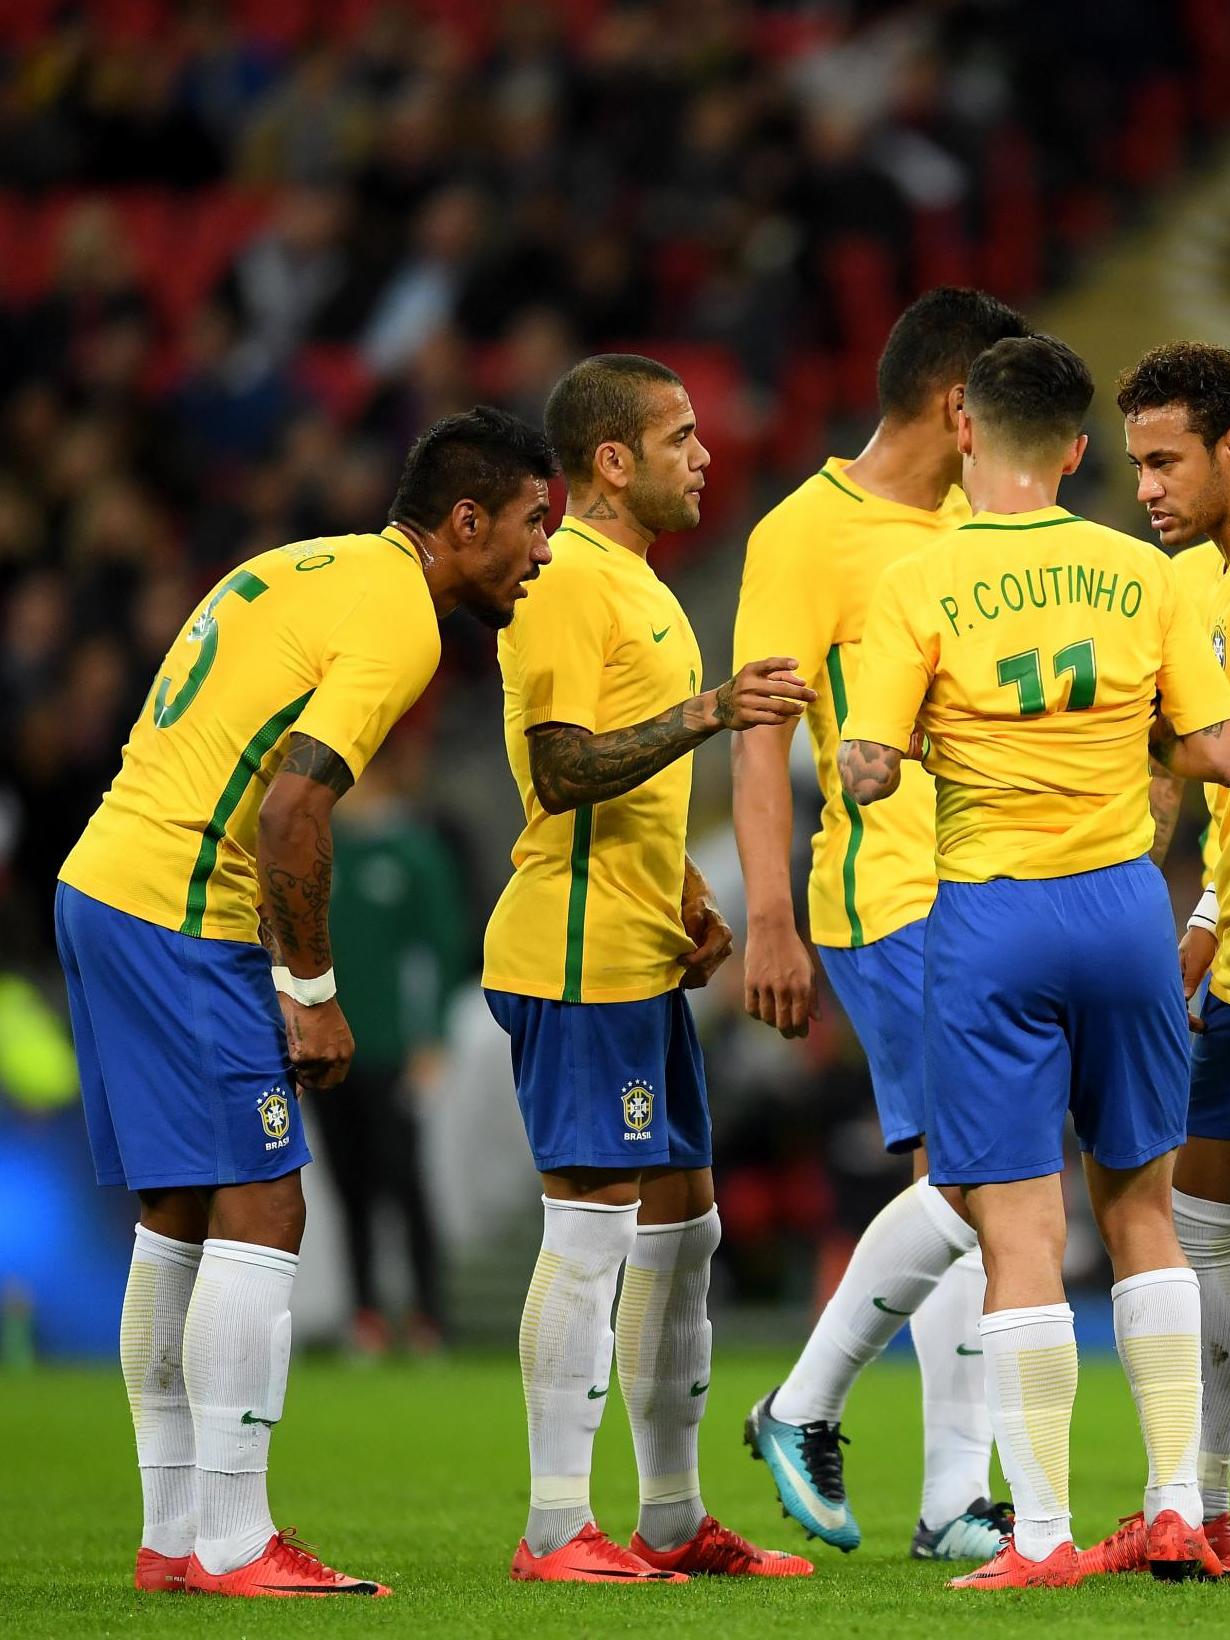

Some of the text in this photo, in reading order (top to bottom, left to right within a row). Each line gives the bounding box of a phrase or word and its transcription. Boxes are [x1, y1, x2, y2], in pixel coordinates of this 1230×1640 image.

[154, 569, 270, 729] 5
[996, 637, 1097, 716] 11
[623, 1131, 651, 1140] BRASIL
